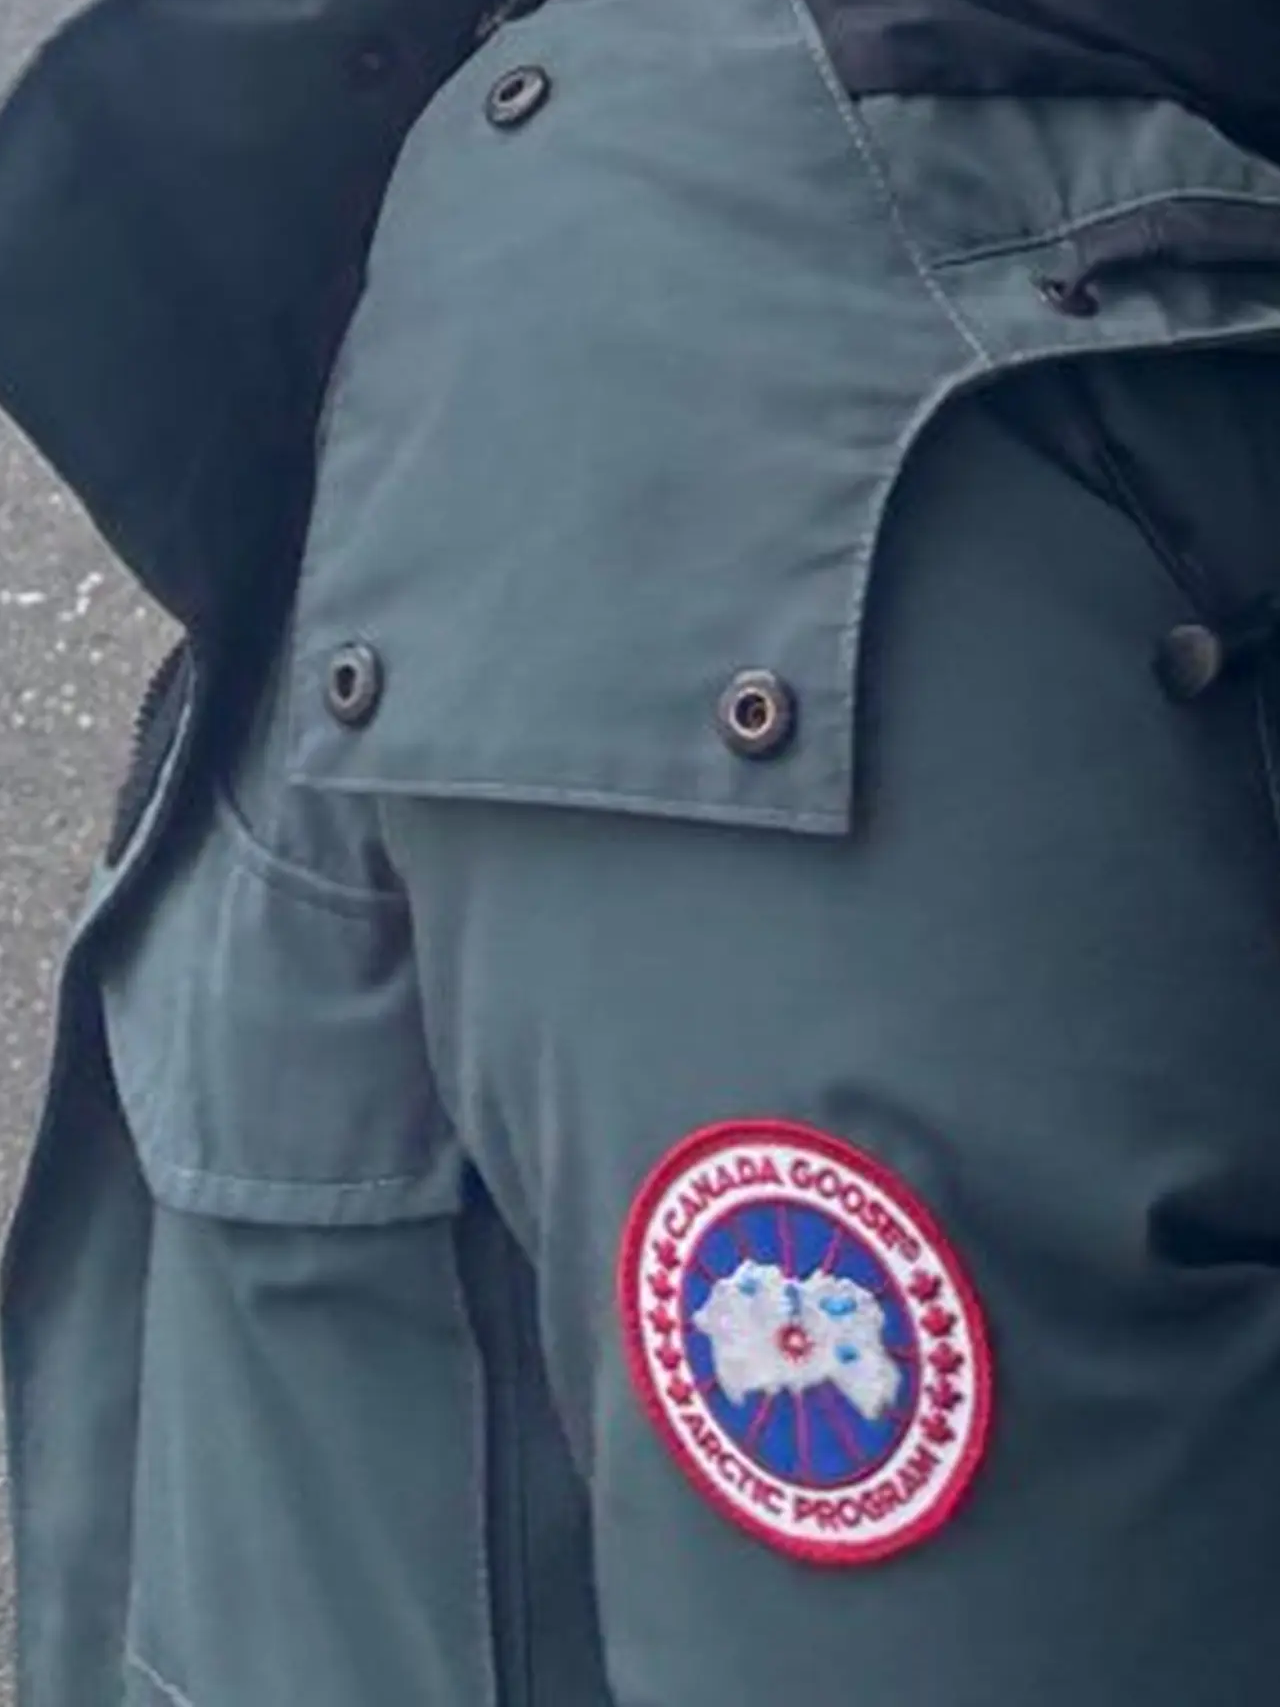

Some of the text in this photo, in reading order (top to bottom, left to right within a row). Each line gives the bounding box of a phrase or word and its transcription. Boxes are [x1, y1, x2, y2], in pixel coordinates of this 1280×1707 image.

[663, 1154, 908, 1252] CANADA GOOSE
[680, 1413, 942, 1532] ARCTIC PROGRAM
